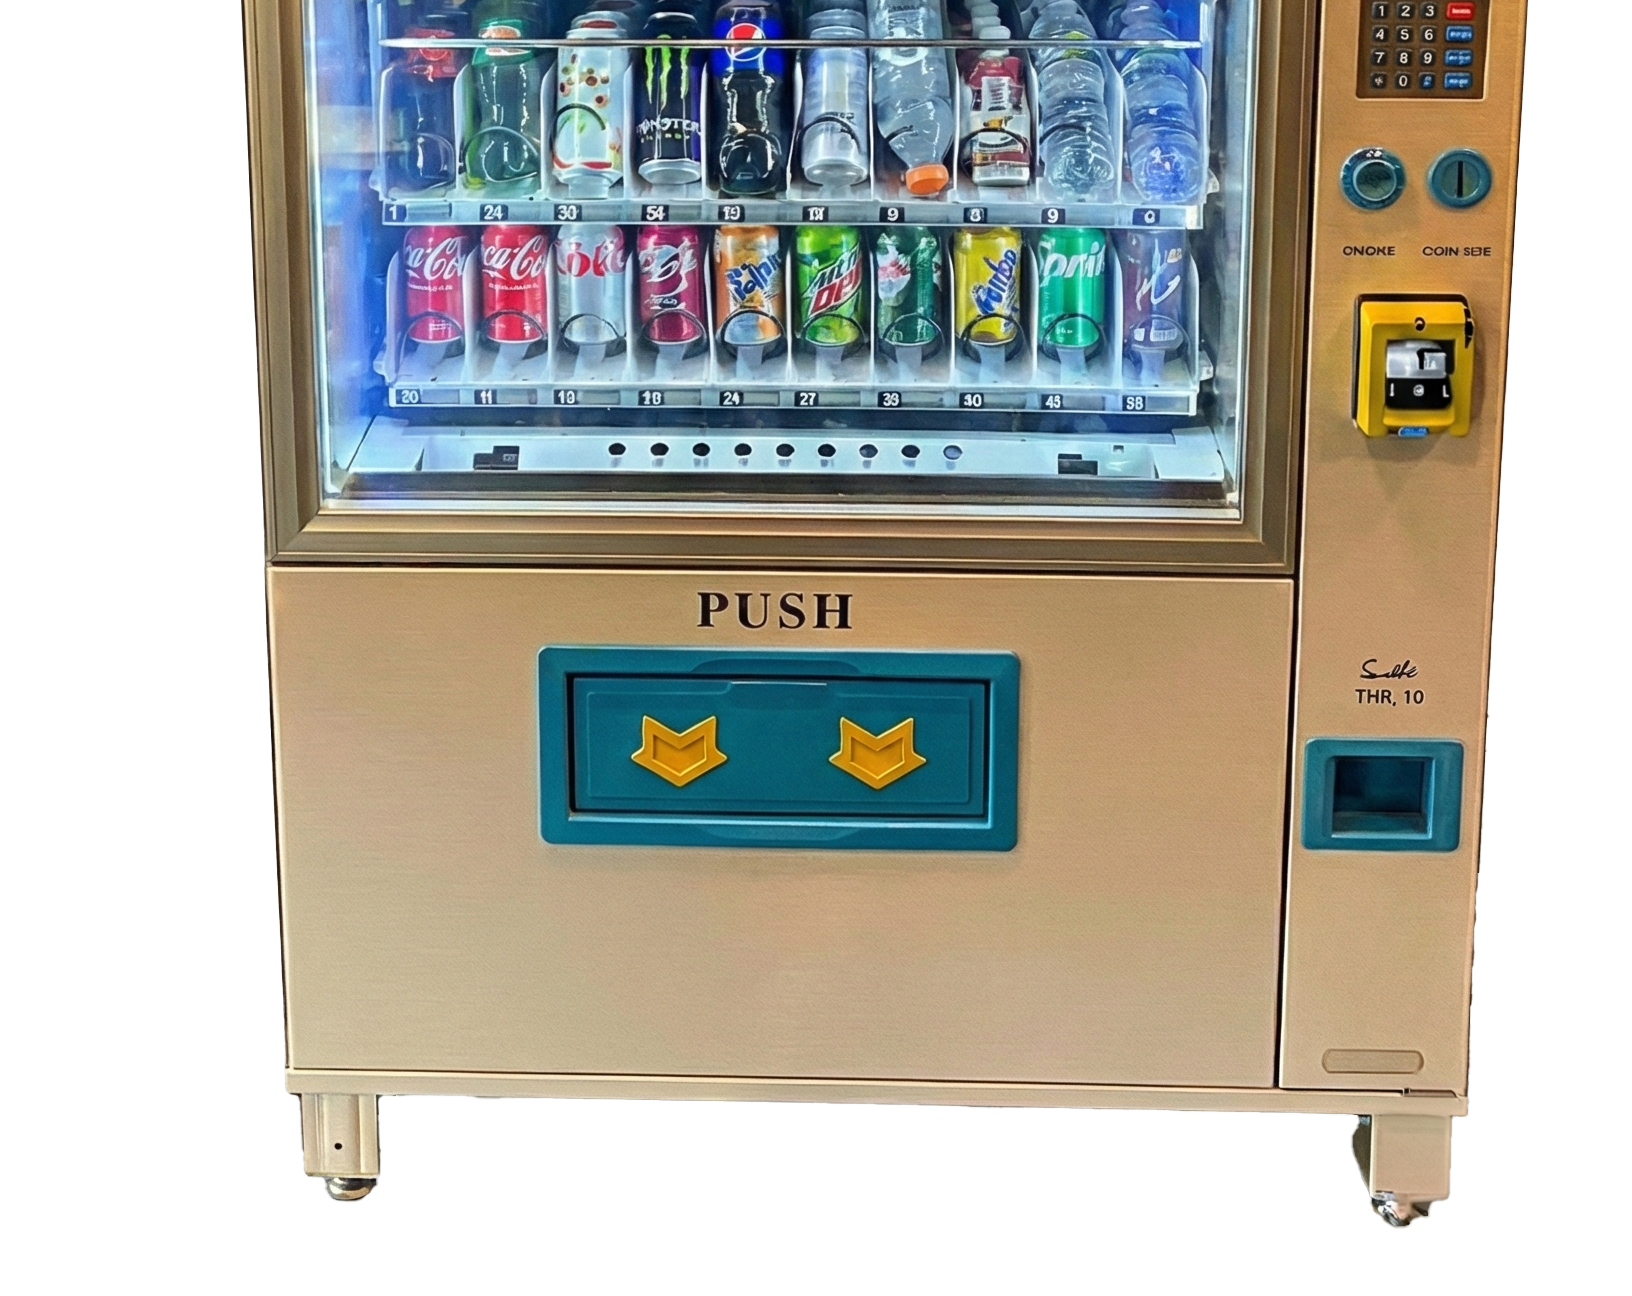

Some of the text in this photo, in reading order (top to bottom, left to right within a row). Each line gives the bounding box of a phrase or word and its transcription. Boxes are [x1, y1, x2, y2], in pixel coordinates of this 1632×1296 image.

[1379, 5, 1434, 17] 1 2 3
[1376, 29, 1385, 40] 4
[1424, 29, 1433, 40] 6
[1375, 52, 1432, 64] 7 8 9
[1399, 75, 1408, 87] 0
[389, 205, 396, 219] 1
[483, 205, 503, 220] 24
[887, 207, 899, 221] 9
[1047, 208, 1059, 223] 9
[1422, 246, 1459, 256] COIN
[401, 390, 419, 403] 20
[799, 393, 816, 406] 27
[697, 592, 853, 629] PUSH
[1404, 689, 1425, 705] 10
